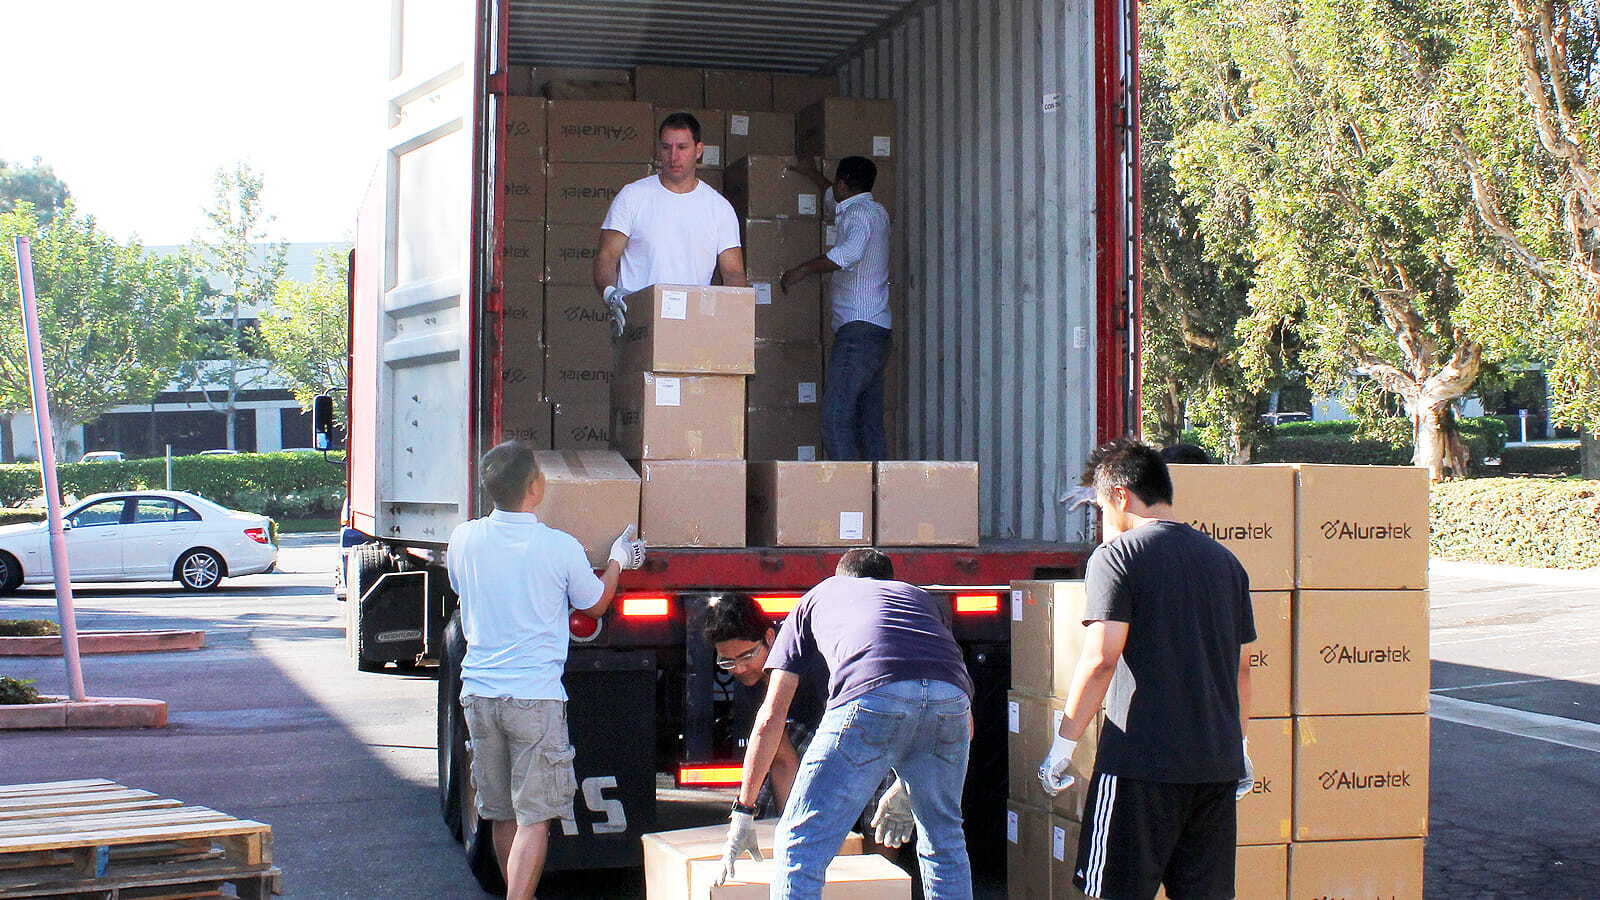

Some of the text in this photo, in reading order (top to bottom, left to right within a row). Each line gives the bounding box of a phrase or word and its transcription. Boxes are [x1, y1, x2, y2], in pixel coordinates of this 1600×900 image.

[561, 124, 622, 140] Aluratek
[560, 247, 598, 262] ratek
[1338, 520, 1412, 540] Aluratek
[1338, 644, 1411, 664] Aluratek
[1338, 770, 1411, 790] Aluratek
